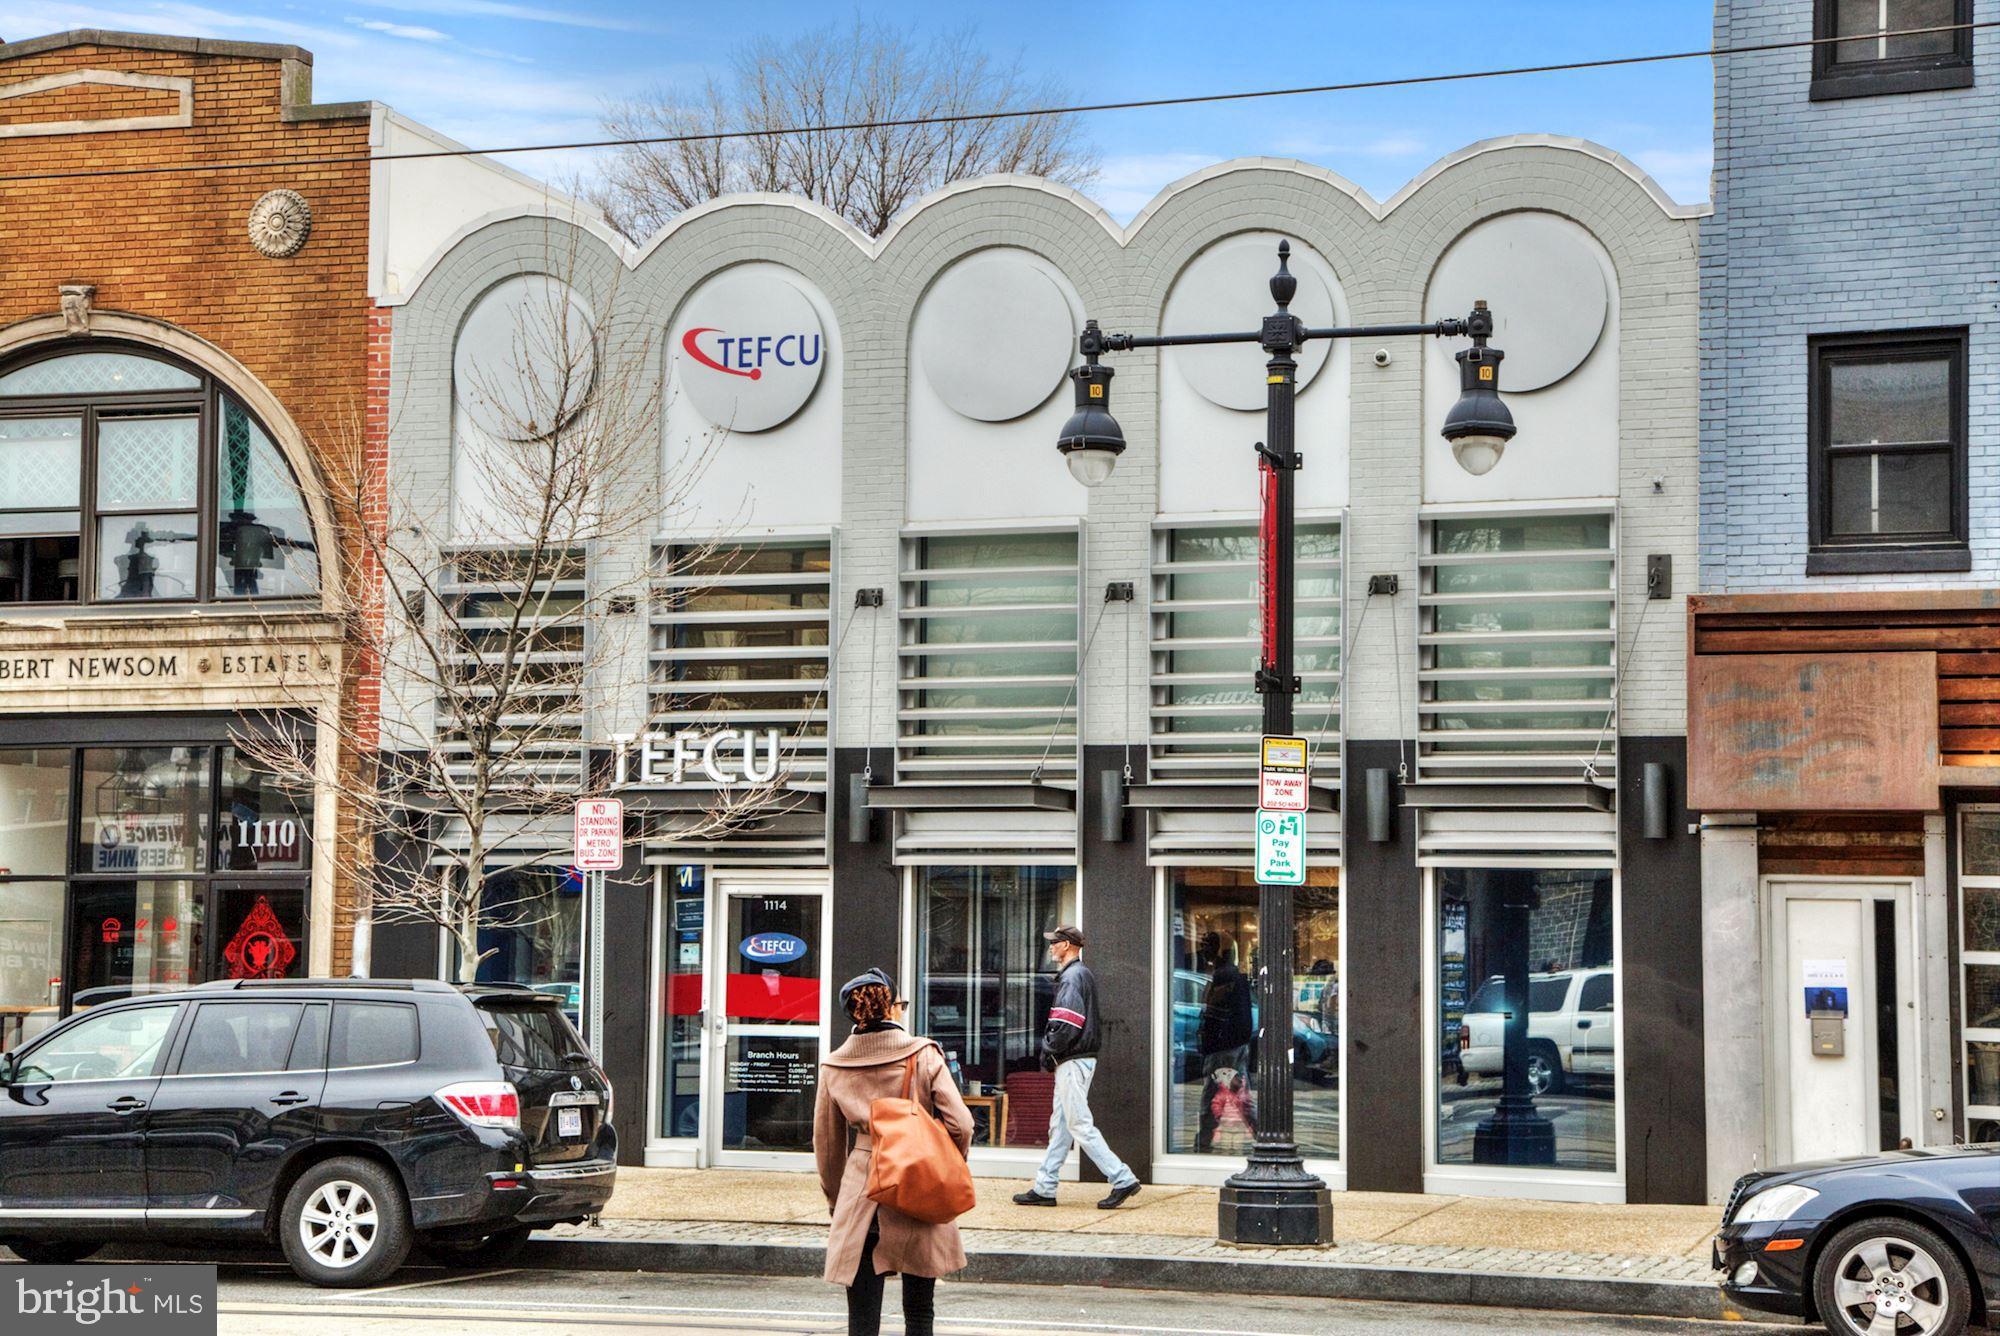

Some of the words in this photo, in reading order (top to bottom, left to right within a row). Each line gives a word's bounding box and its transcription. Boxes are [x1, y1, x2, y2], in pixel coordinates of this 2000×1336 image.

[717, 334, 820, 368] TEFCU
[1481, 368, 1491, 379] 10
[1091, 386, 1101, 396] 10
[68, 655, 177, 678] NEWSOM
[222, 655, 308, 674] ESTATE
[608, 729, 781, 784] TEFCU
[1266, 779, 1282, 787] TOW
[1284, 780, 1303, 788] AWAY
[592, 805, 606, 814] NO
[580, 817, 618, 826] STANDING
[238, 820, 296, 848] 1110
[579, 828, 589, 837] OR
[591, 828, 618, 837] PARKING
[1272, 838, 1289, 847] Pay
[579, 849, 595, 857] BUS
[598, 849, 617, 857] ZONE
[1276, 850, 1287, 858] To
[764, 900, 787, 910] 1114
[761, 940, 793, 952] TEFCU
[748, 1051, 775, 1059] Branch
